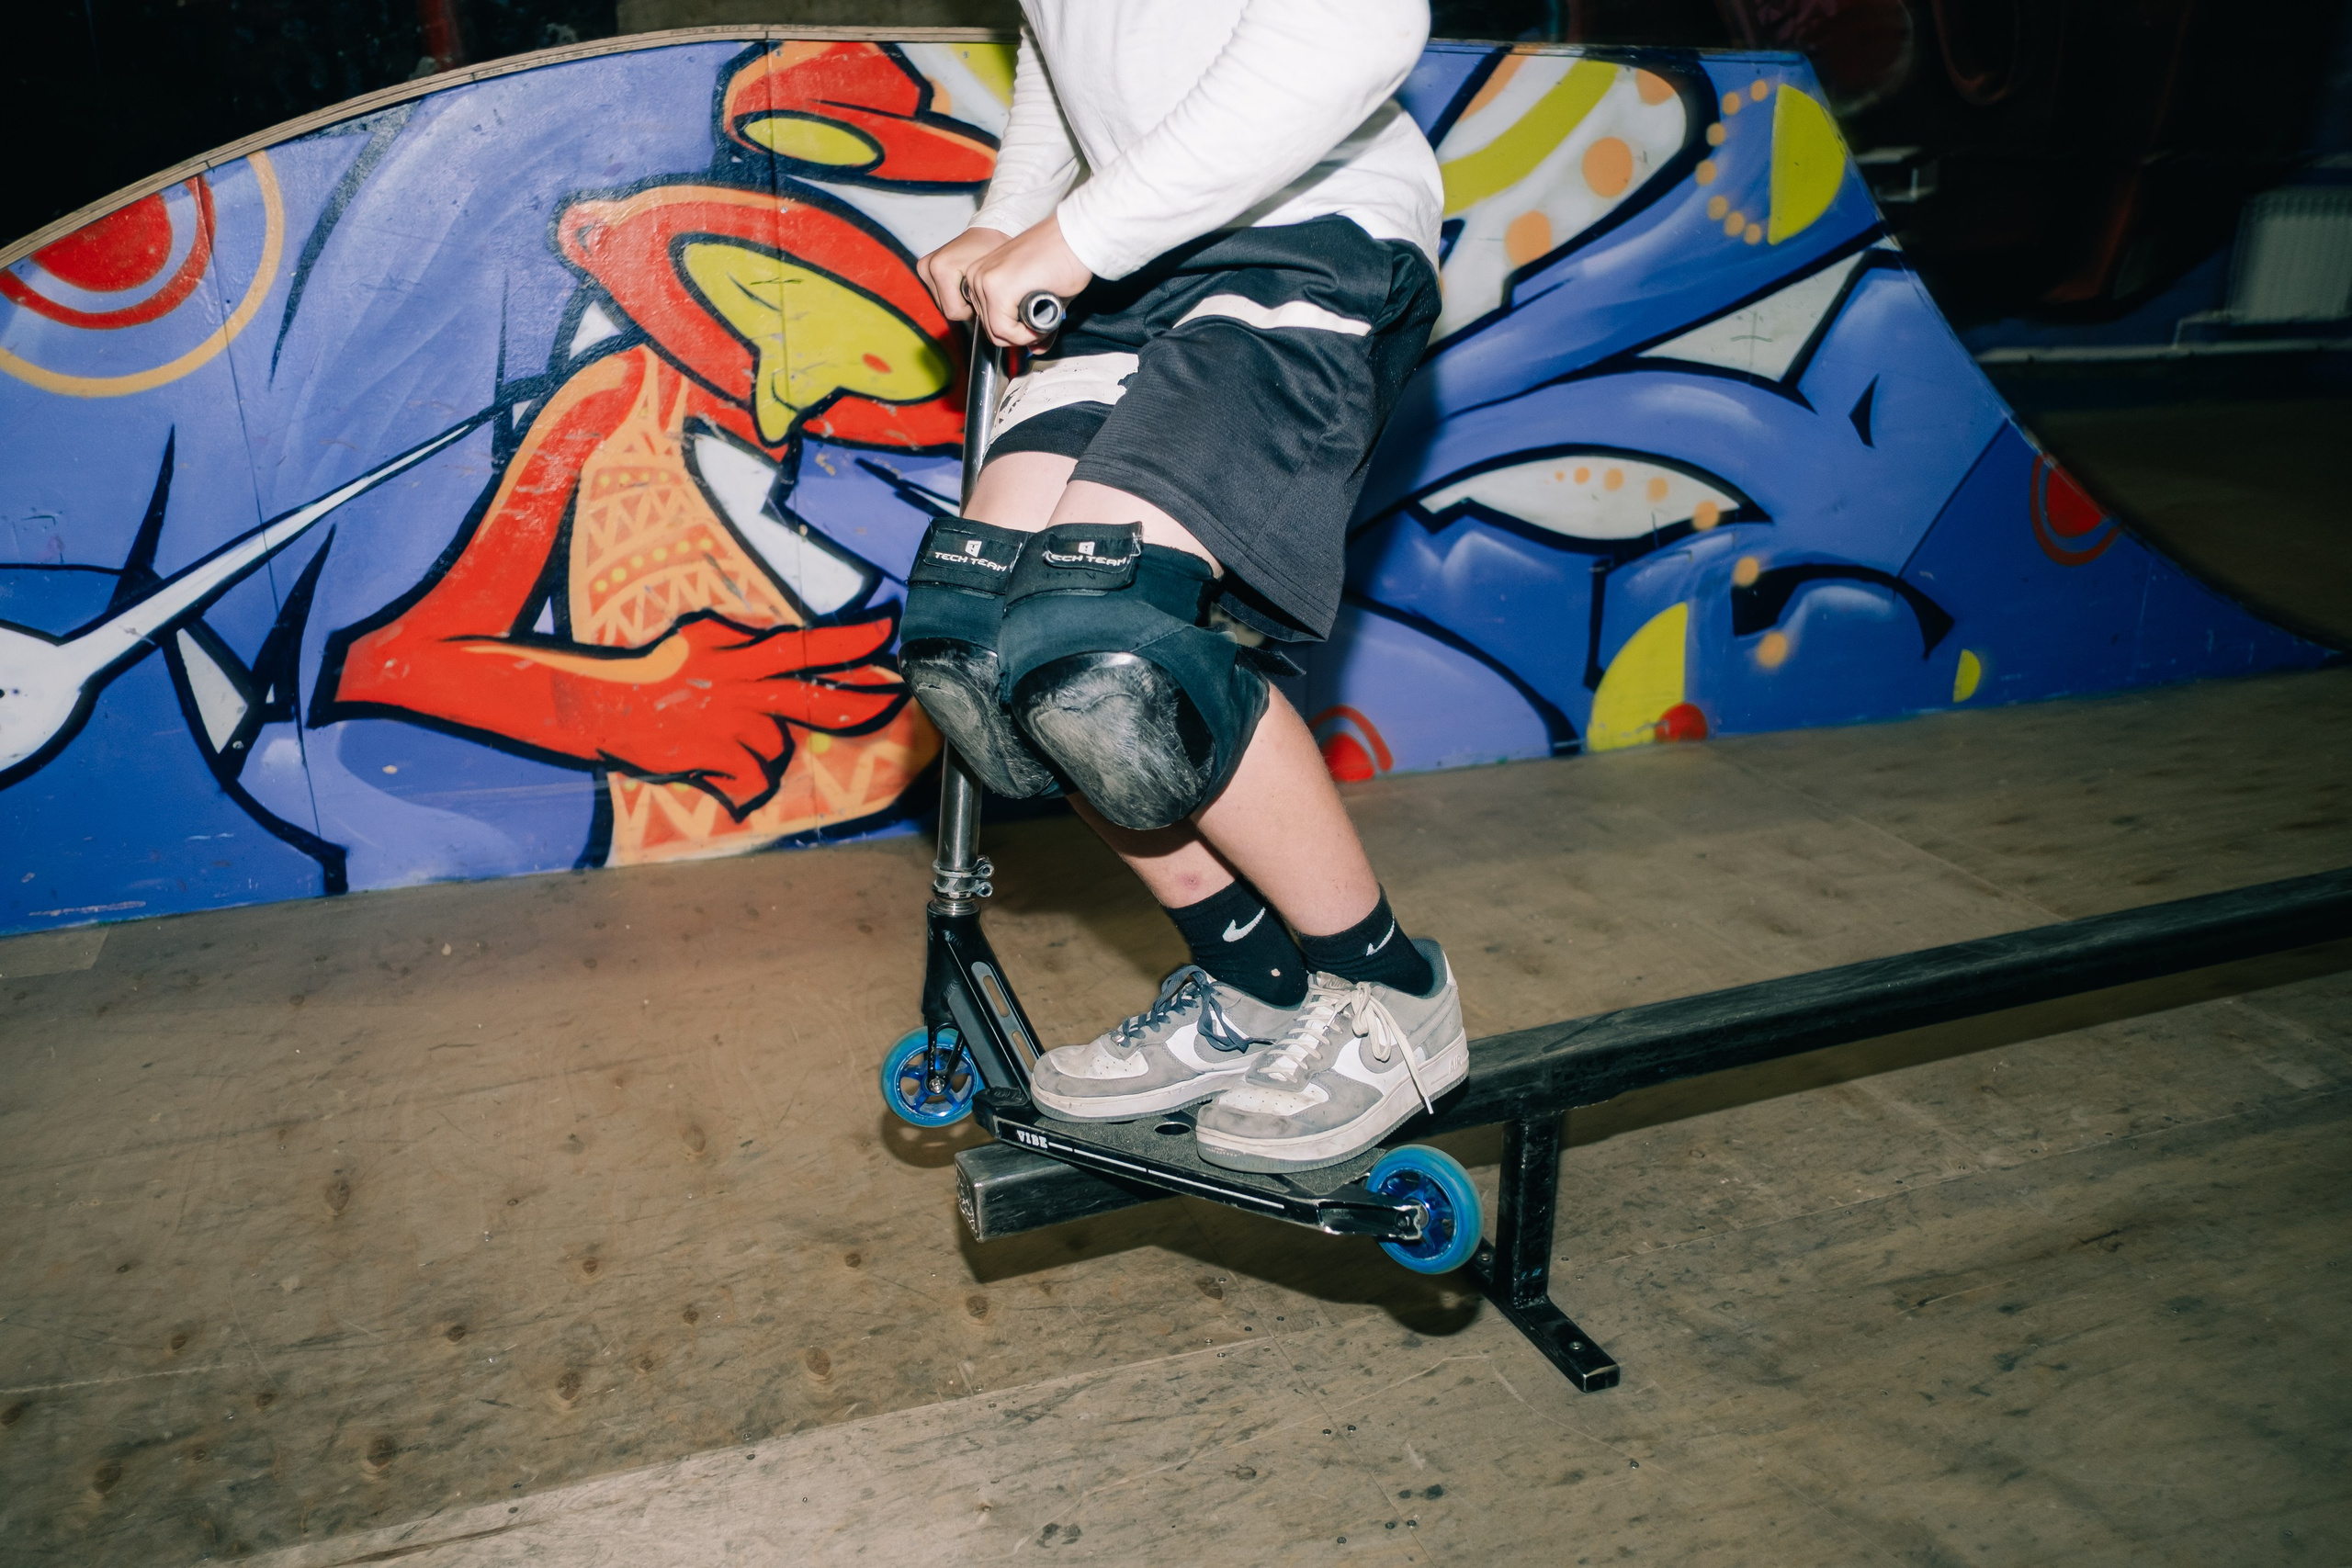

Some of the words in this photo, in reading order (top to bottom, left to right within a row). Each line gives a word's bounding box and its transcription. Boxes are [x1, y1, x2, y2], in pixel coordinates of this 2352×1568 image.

[934, 552, 968, 563] TECH
[970, 558, 1007, 571] TEAM
[1086, 556, 1126, 566] TEAM
[1448, 1055, 1463, 1075] AIR
[1016, 1130, 1048, 1148] VIBE
